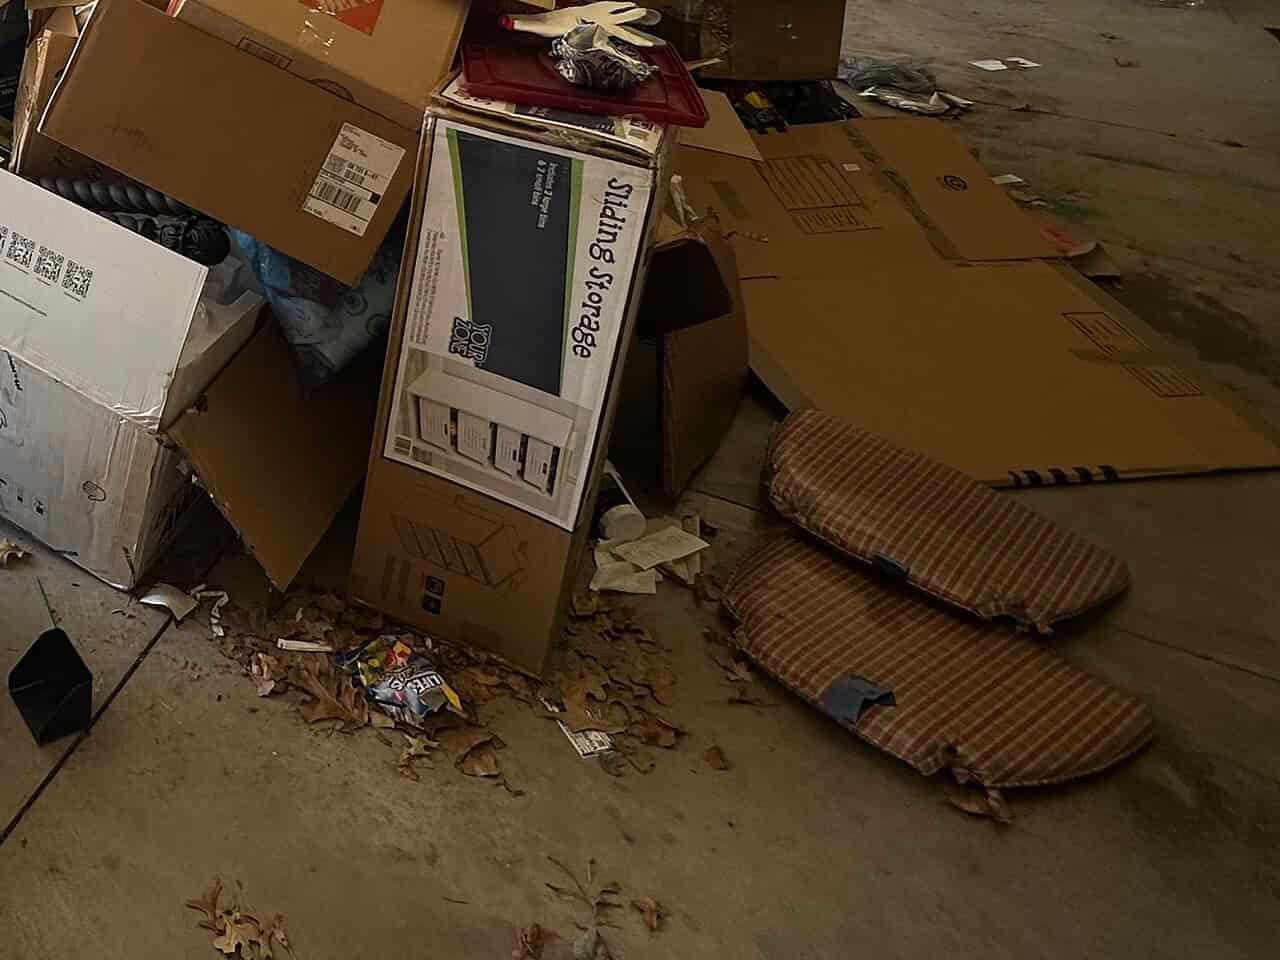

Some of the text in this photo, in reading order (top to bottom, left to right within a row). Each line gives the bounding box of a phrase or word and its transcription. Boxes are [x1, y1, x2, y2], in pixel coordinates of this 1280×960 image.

[572, 177, 633, 358] Sliding Storage
[450, 317, 470, 356] ZONE
[468, 321, 493, 362] YOUR
